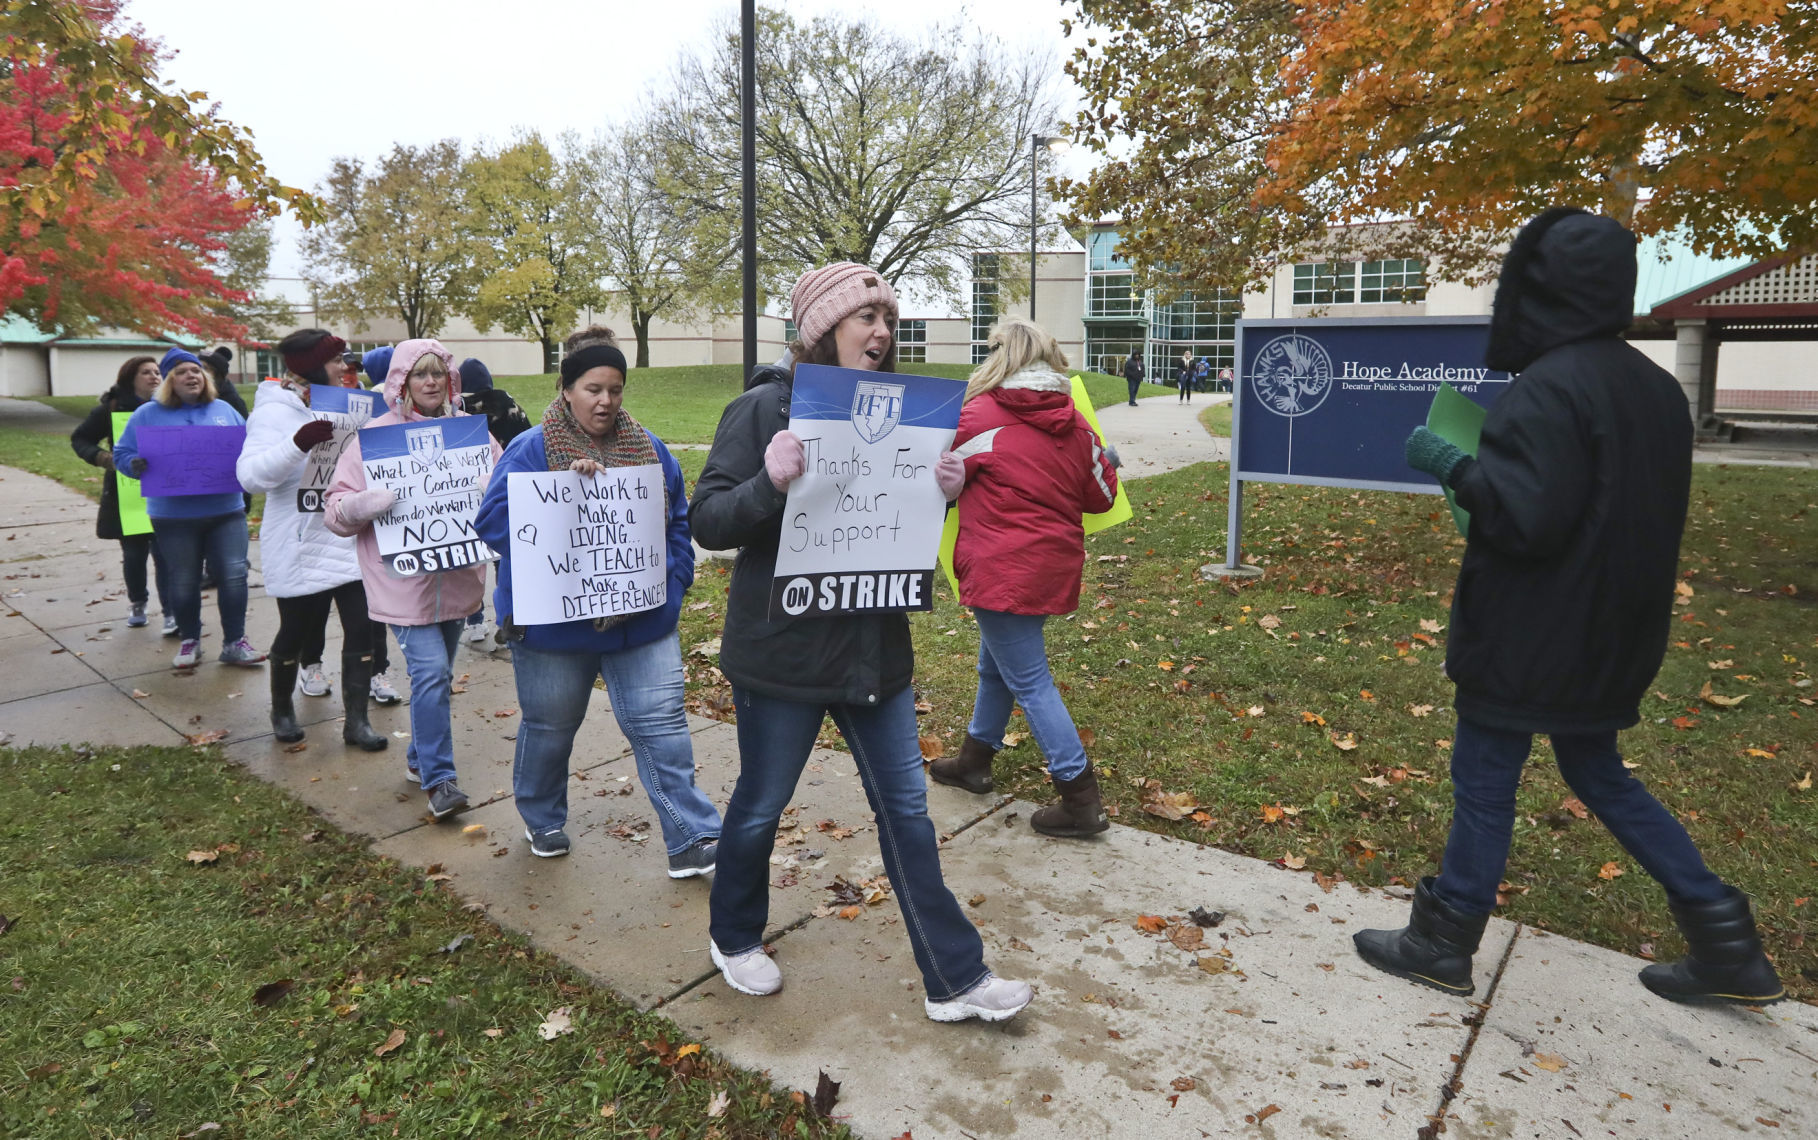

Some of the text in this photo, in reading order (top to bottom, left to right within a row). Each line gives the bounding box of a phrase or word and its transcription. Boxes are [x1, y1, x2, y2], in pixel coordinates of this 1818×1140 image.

[1256, 342, 1285, 401] HAWKS
[1342, 361, 1488, 384] Hope Academy
[1342, 383, 1478, 393] Decatur Public School Dist #61
[856, 393, 900, 419] IFT
[409, 434, 441, 452] IFT
[366, 460, 407, 481] What
[411, 461, 428, 475] Do
[435, 455, 453, 472] We
[802, 438, 927, 479] Thanks For
[423, 467, 482, 495] Contrac
[532, 477, 648, 503] We Work to
[304, 495, 317, 507] ON
[835, 483, 887, 513] Your
[376, 508, 410, 528] When
[411, 505, 425, 520] do
[577, 504, 636, 524] Make a
[569, 524, 641, 548] LIVING...
[790, 511, 901, 554] Support
[397, 540, 502, 572] ON STRIK
[548, 545, 660, 576] We TEACH to
[581, 578, 637, 594] Make a
[786, 573, 923, 611] ON STRIKE
